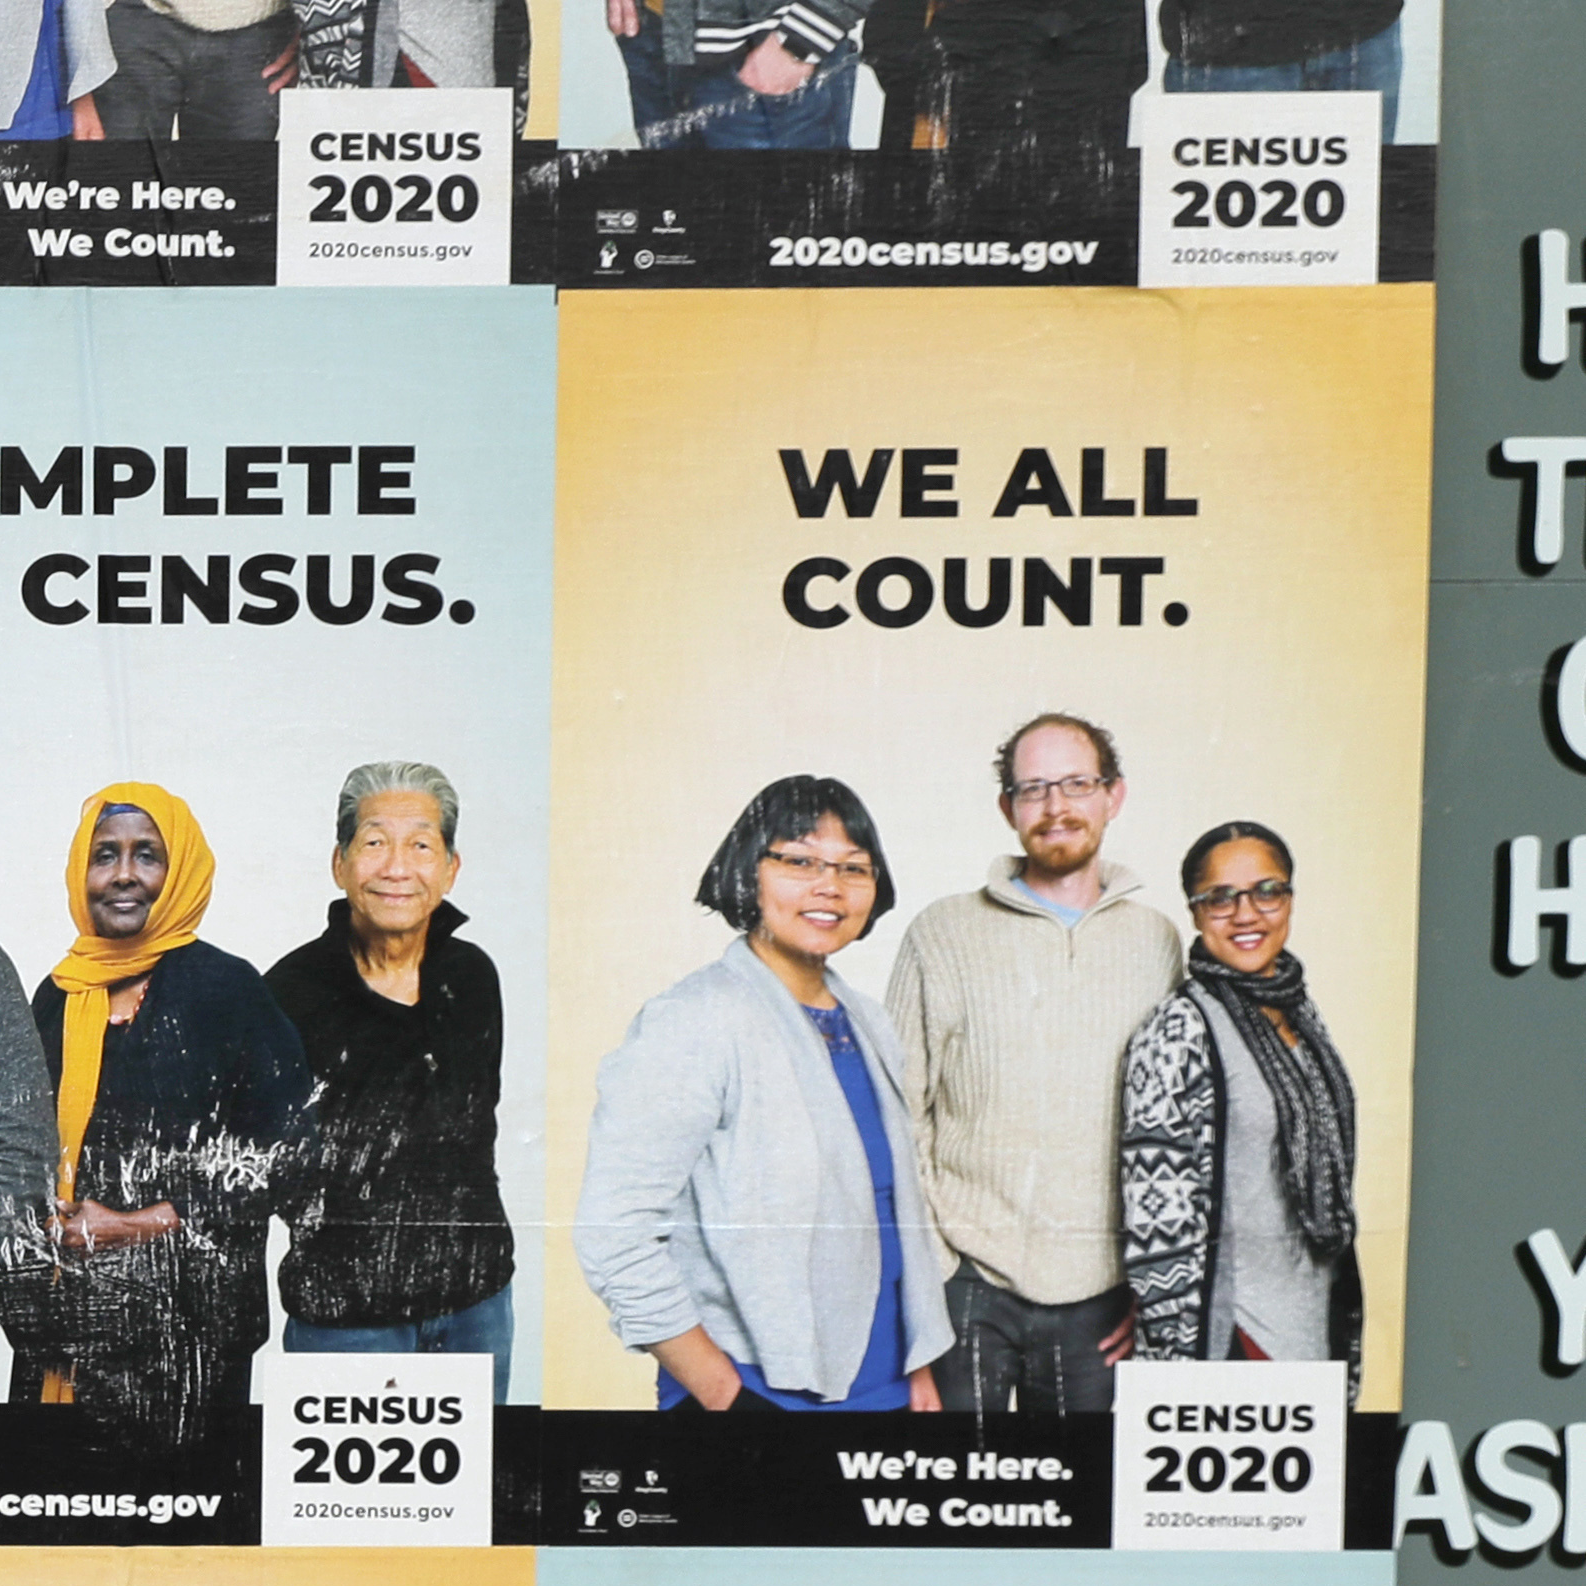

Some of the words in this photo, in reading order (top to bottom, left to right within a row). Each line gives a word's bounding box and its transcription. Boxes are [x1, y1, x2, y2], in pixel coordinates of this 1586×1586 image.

[310, 132, 482, 162] CENSUS
[1173, 136, 1348, 167] CENSUS
[3, 180, 125, 211] We're
[131, 181, 236, 211] Here.
[308, 174, 480, 224] 2020
[1172, 179, 1345, 229] 2020
[27, 227, 94, 258] We
[104, 227, 236, 258] Count.
[309, 242, 473, 262] 2020census.gov
[769, 236, 1099, 272] 2020census.gov
[1172, 247, 1339, 267] 2020census.gov
[778, 448, 959, 519] WE
[991, 447, 1199, 518] ALL
[21, 552, 476, 626] CENSUS.
[782, 556, 1189, 630] COUNT.
[293, 1395, 463, 1425] CENSUS
[1146, 1404, 1314, 1433] CENSUS
[292, 1436, 461, 1485] 2020
[837, 1450, 957, 1480] We're
[967, 1452, 1073, 1481] Here.
[1145, 1445, 1312, 1494] 2020
[293, 1503, 455, 1523] 2020census.gov
[862, 1497, 930, 1527] We
[939, 1497, 1072, 1527] Count.
[1144, 1511, 1306, 1532] 2020census.gov
